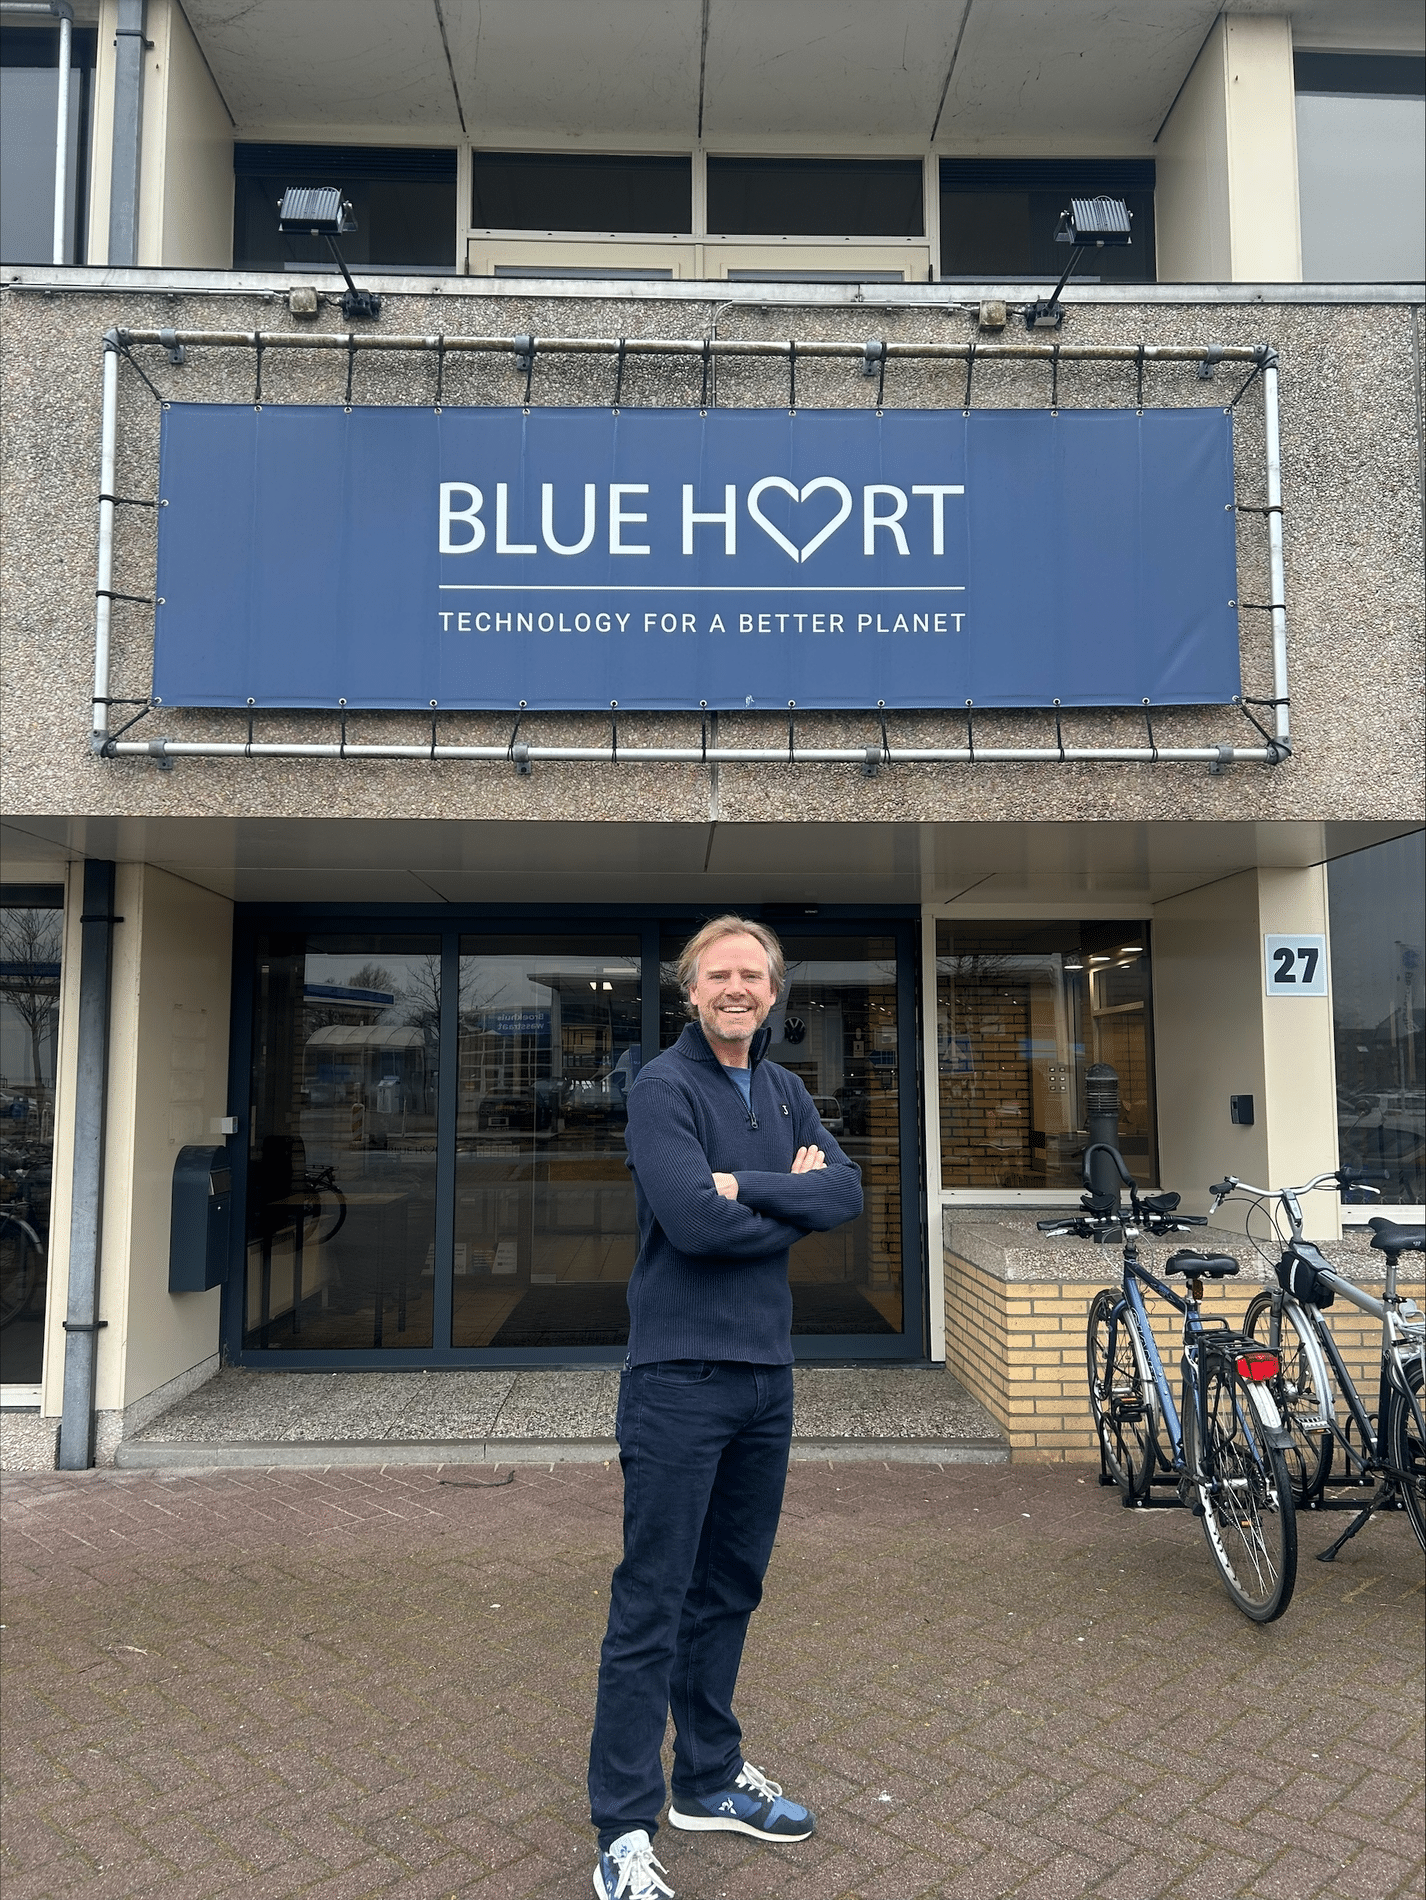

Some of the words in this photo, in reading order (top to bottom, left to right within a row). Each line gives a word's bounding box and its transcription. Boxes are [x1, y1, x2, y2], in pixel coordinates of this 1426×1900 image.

[438, 481, 651, 556] BLUE
[438, 611, 632, 633] TECHNOLOGY
[644, 612, 698, 633] FOR
[708, 612, 726, 633] A
[738, 612, 845, 633] BETTER
[857, 612, 966, 633] PLANET
[1273, 947, 1319, 984] 27
